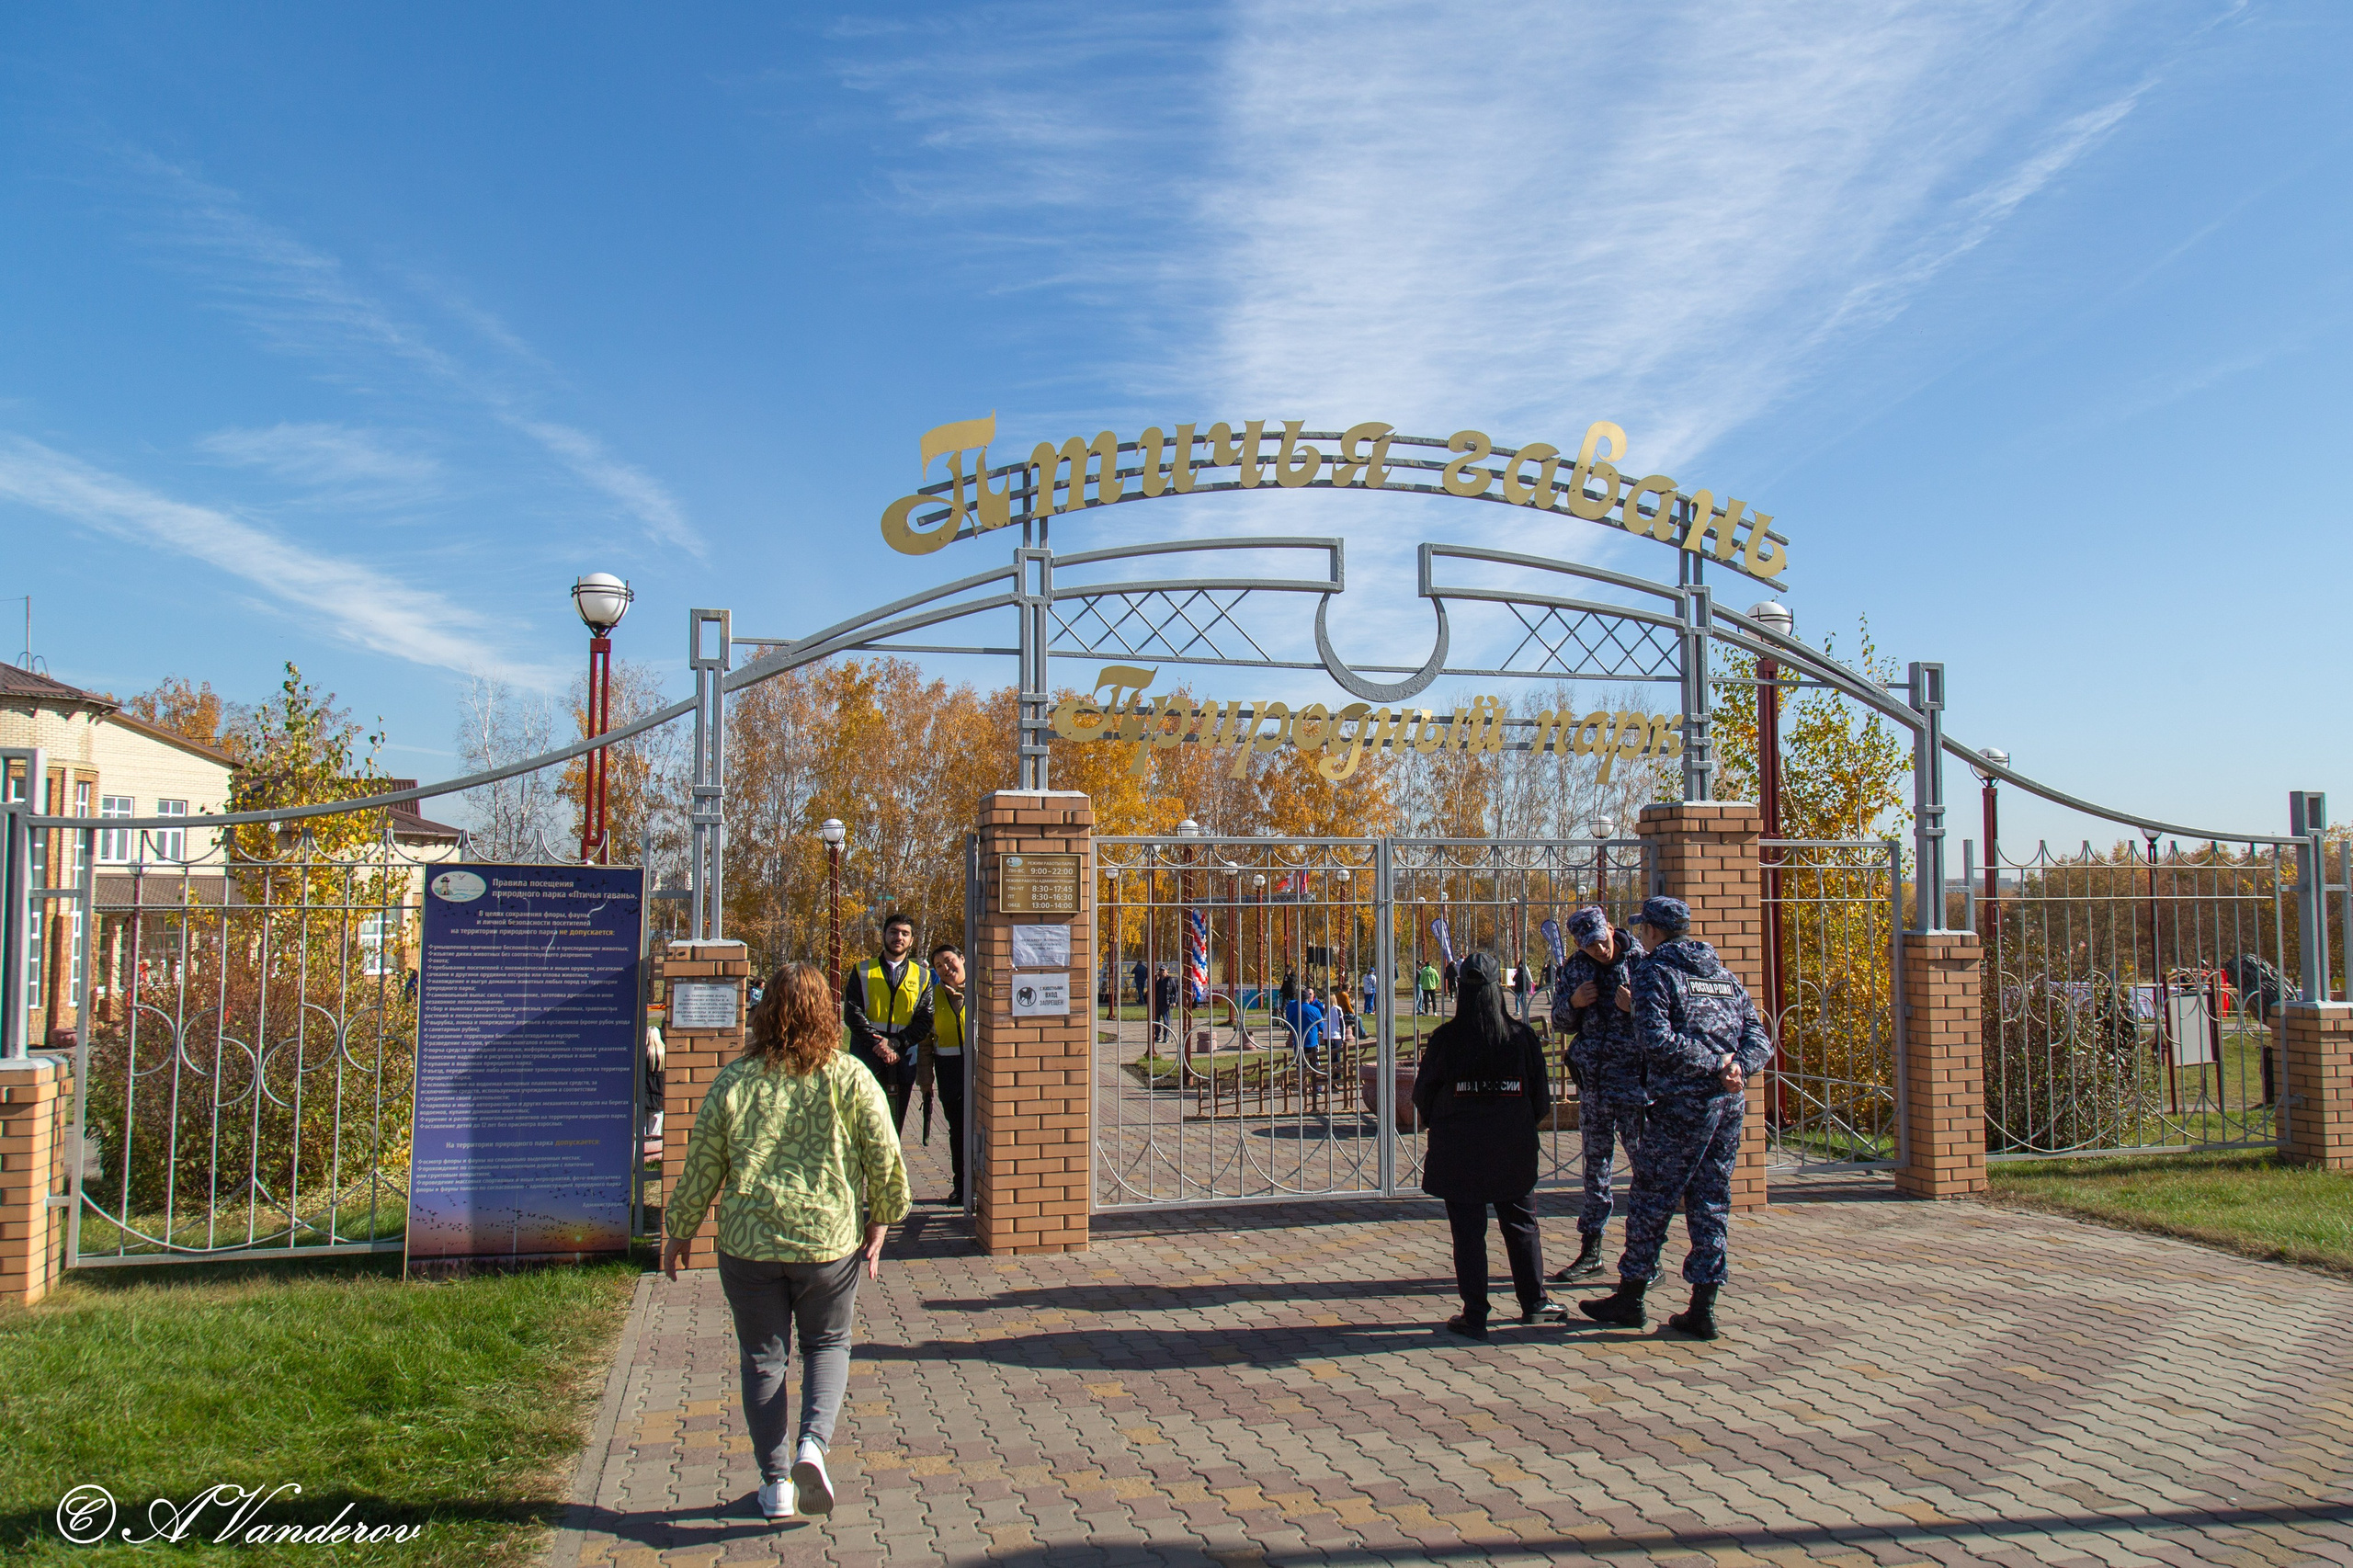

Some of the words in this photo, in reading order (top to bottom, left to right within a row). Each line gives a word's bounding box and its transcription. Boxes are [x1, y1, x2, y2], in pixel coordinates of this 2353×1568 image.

[880, 408, 1396, 556] Птичья
[1442, 419, 1788, 579] гавань
[1052, 665, 1506, 780] Природный
[1533, 710, 1684, 785] парк
[492, 878, 527, 888] Правила
[491, 890, 540, 898] природного
[1690, 981, 1732, 995] РОСГВАРДИЯ
[1482, 1081, 1520, 1091] РСИИ
